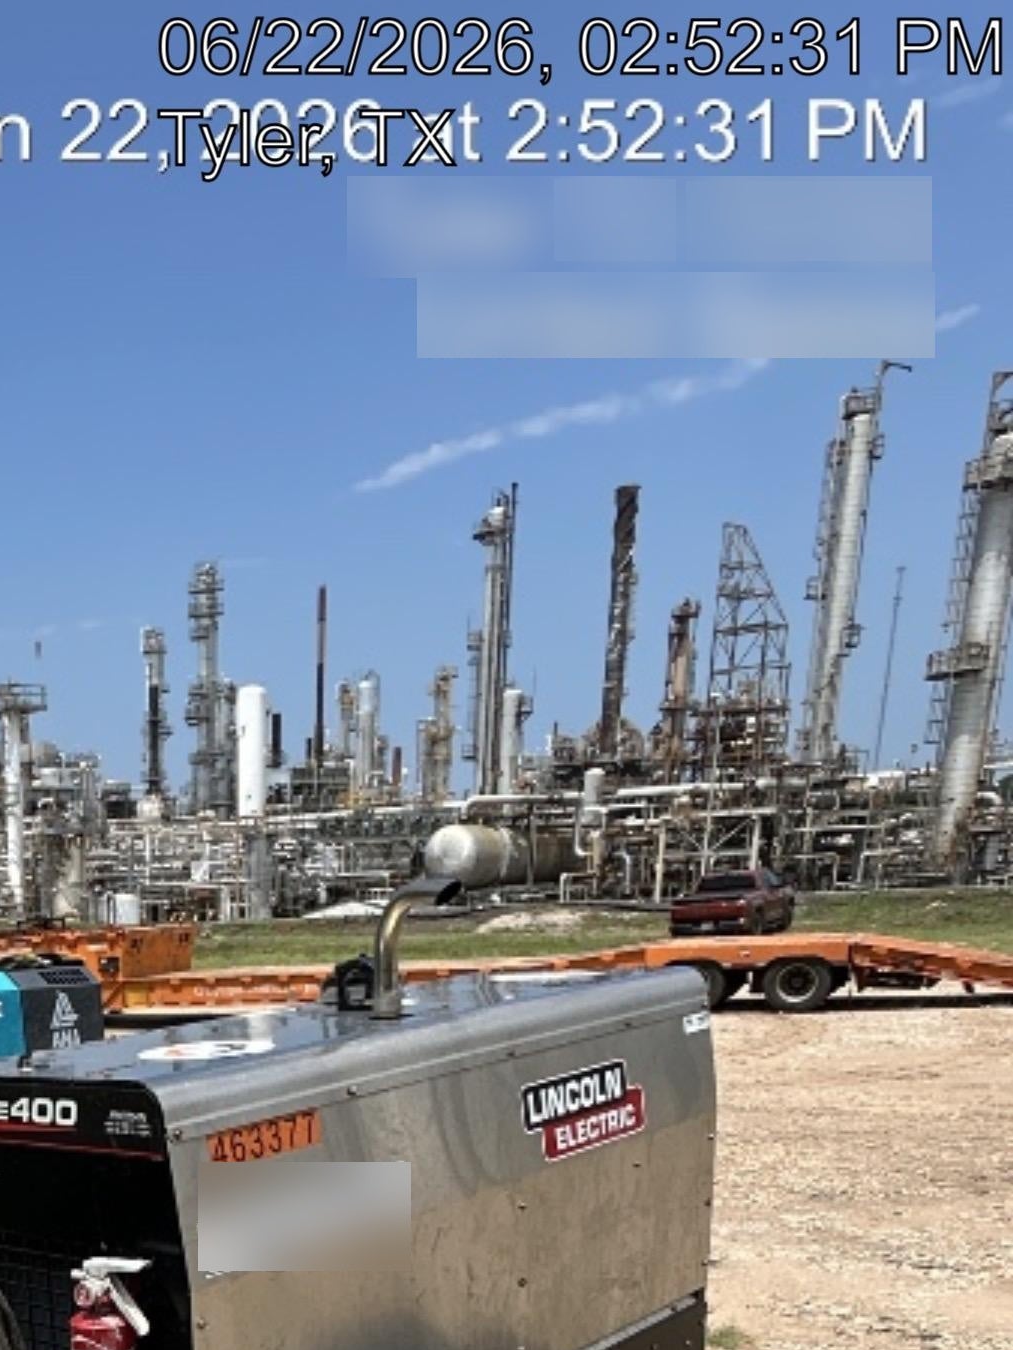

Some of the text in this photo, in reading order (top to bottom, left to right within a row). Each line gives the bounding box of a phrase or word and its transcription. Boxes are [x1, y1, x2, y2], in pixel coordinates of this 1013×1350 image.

[525, 1066, 623, 1125] LINCOLN
[211, 1108, 317, 1162] 463377
[554, 1104, 637, 1151] ELECTRIC
